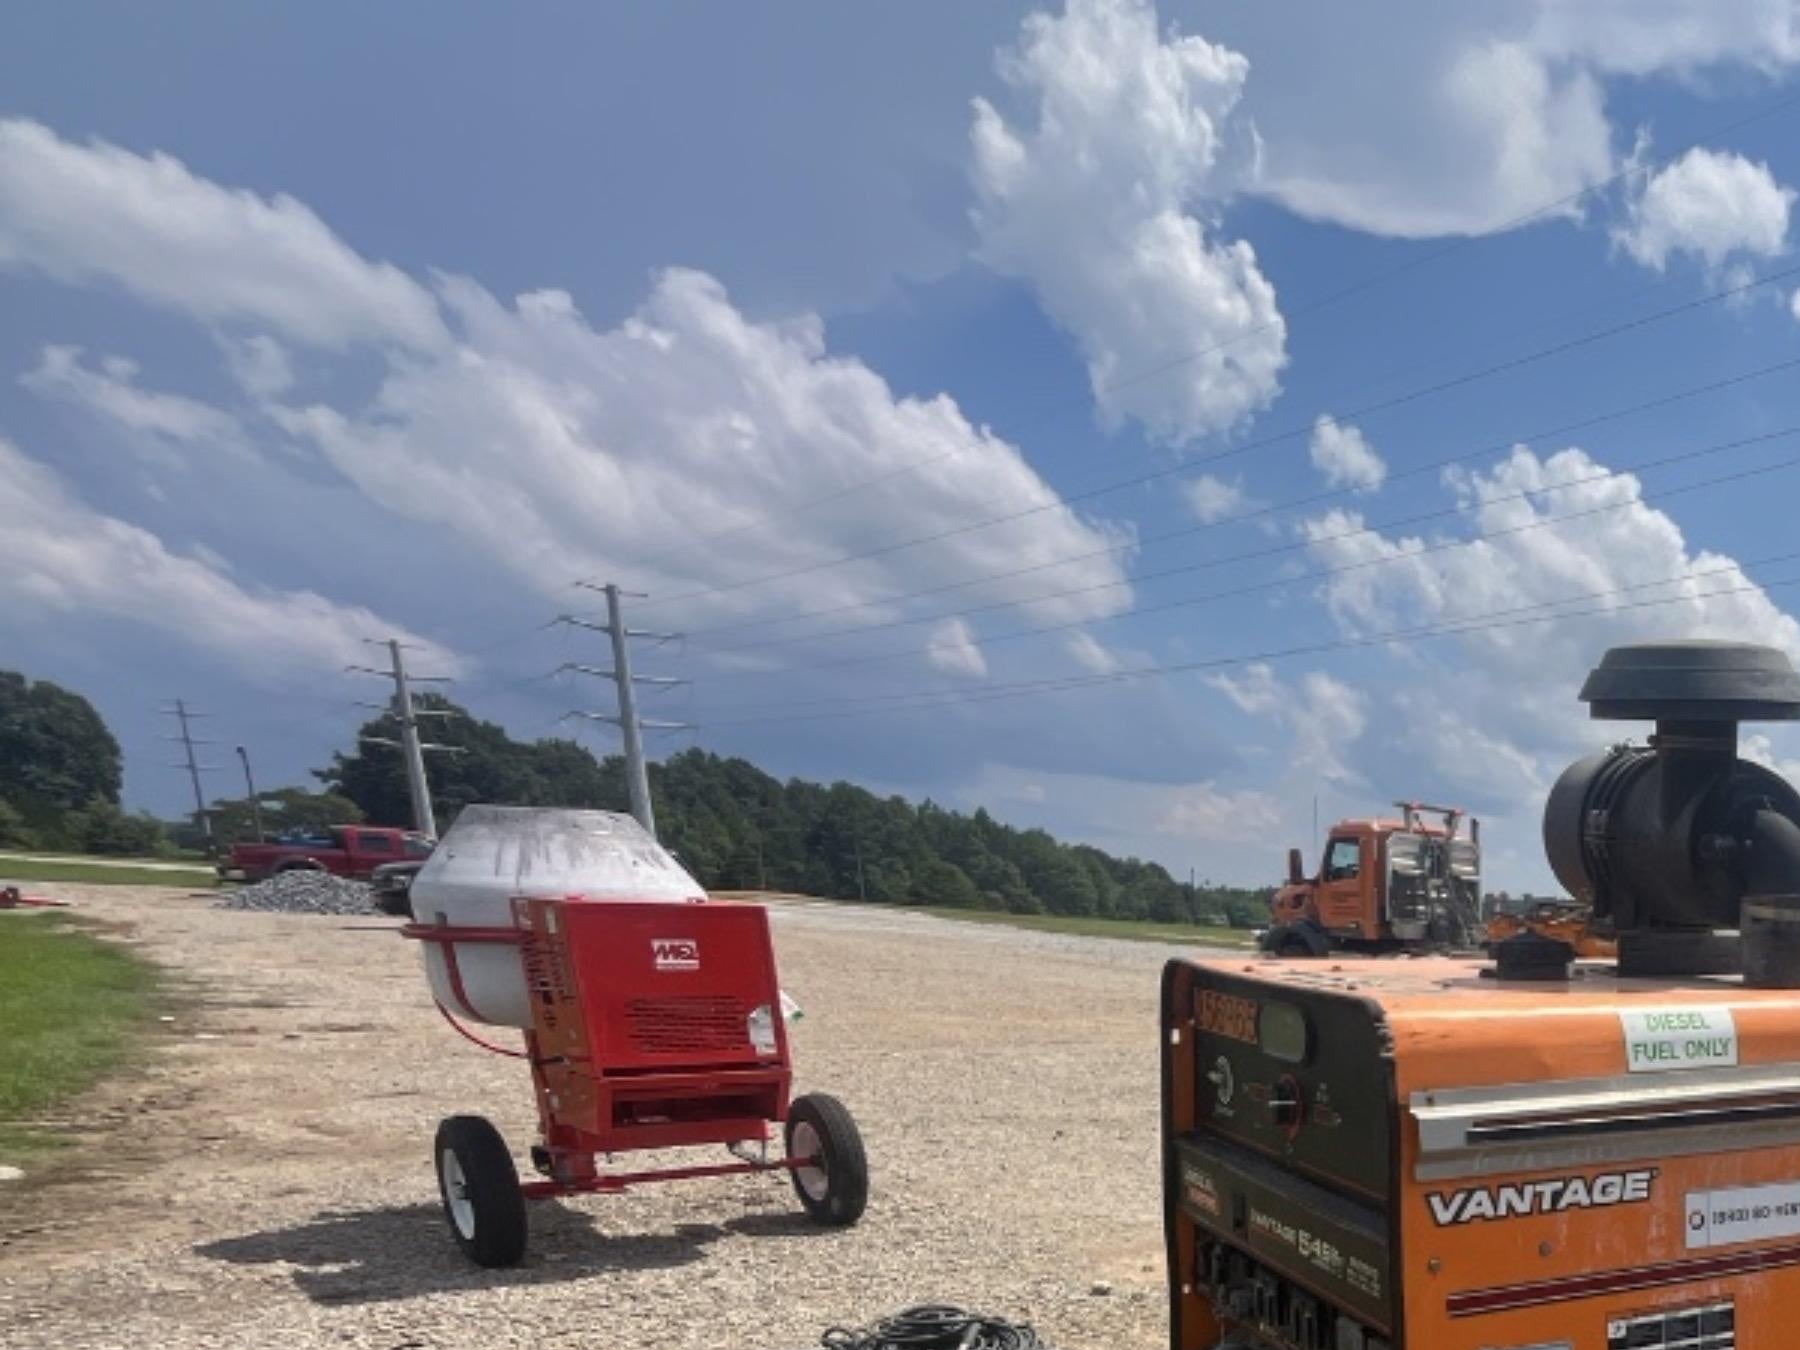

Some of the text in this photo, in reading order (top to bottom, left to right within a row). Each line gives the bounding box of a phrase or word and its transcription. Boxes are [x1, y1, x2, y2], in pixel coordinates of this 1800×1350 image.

[1644, 1012, 1712, 1034] DIESEL
[1632, 1037, 1732, 1062] FUEL ONLY
[1427, 1171, 1654, 1227] VANTAGE
